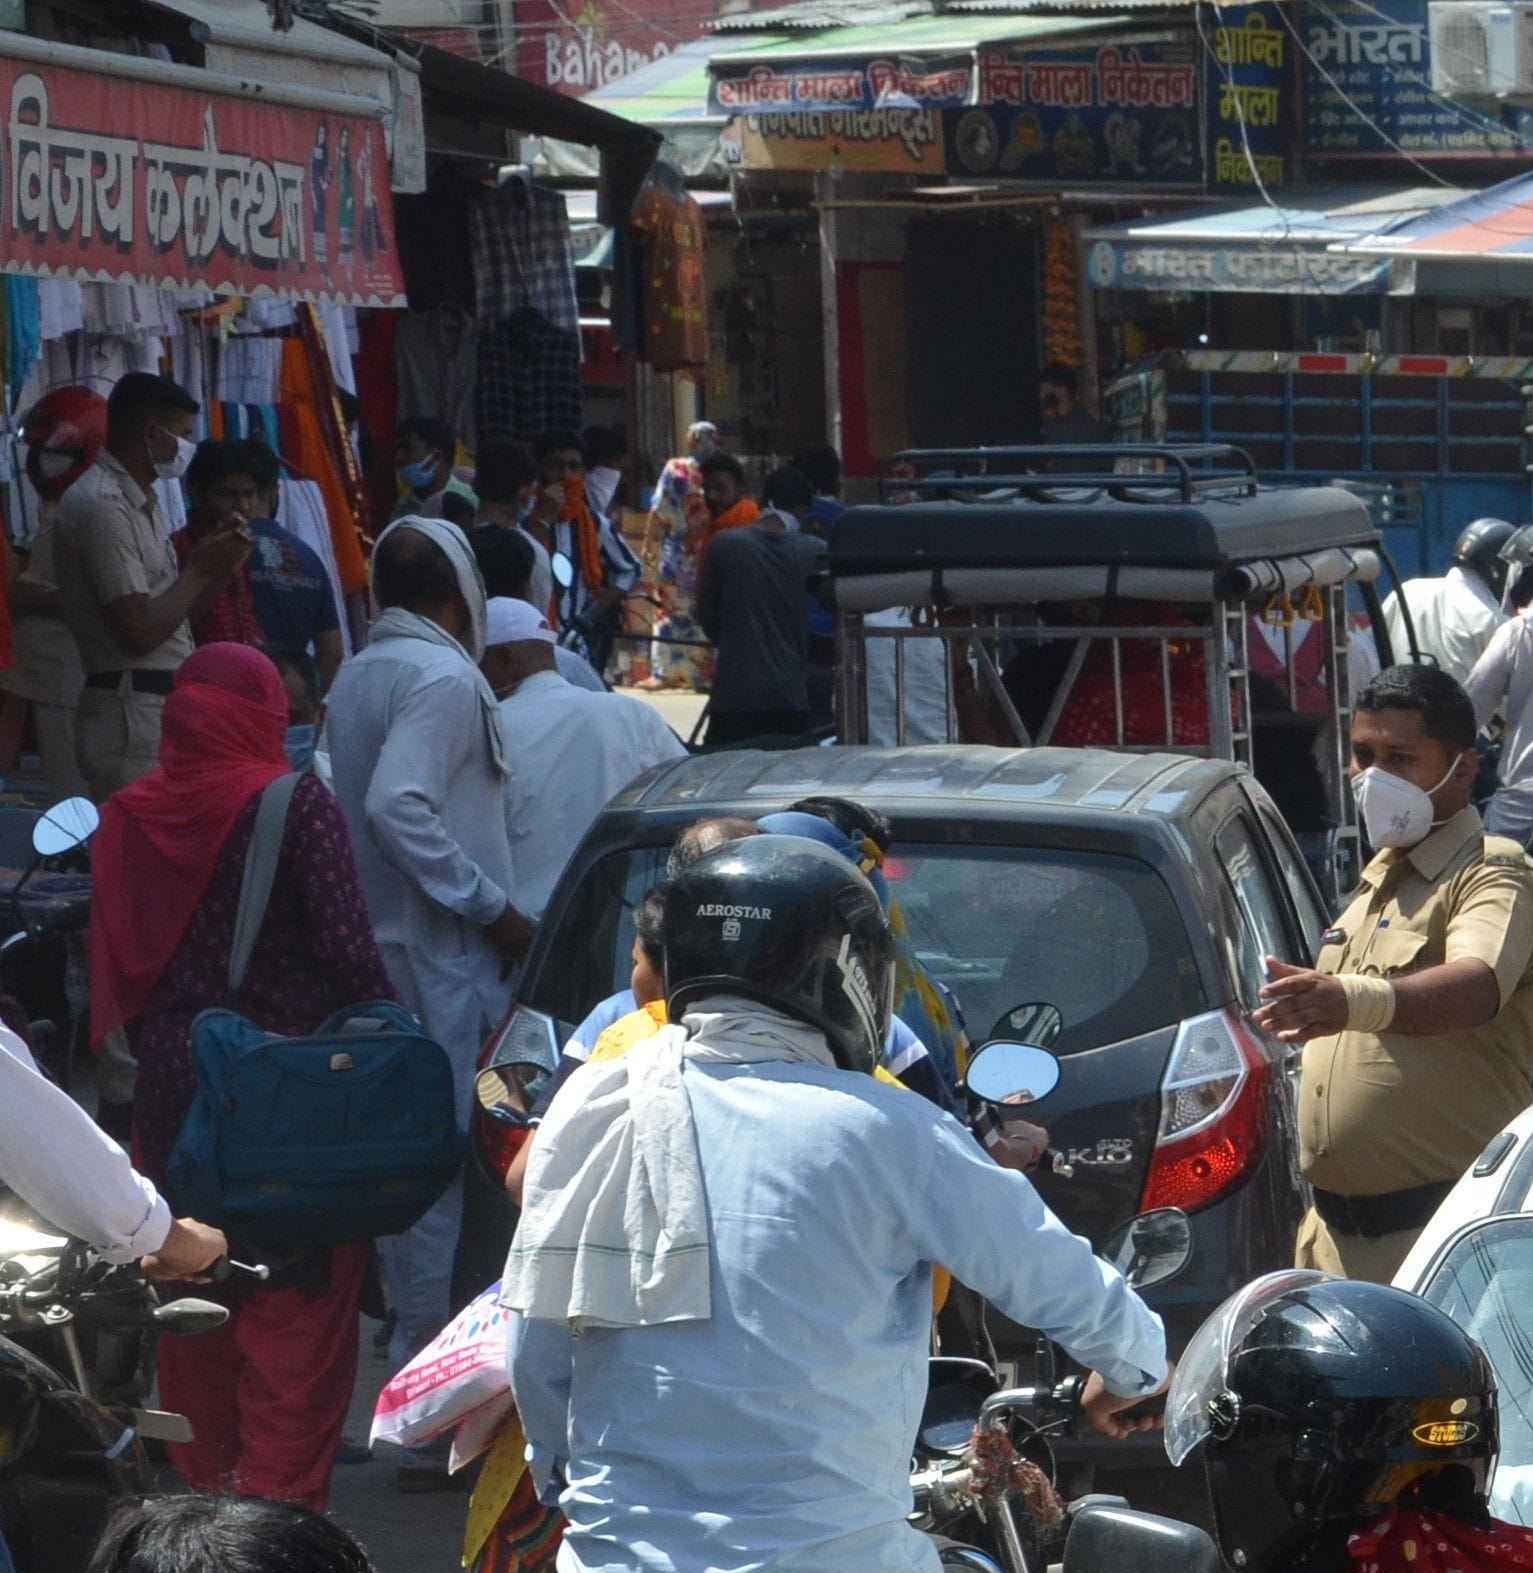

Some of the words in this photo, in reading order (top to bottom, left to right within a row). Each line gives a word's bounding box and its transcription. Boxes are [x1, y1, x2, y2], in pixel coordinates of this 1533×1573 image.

[1308, 22, 1427, 65] भारत
[796, 70, 862, 103] माला
[1028, 61, 1093, 107] माला
[1096, 45, 1196, 108] निकेतन
[8, 74, 139, 248] विजय
[143, 104, 306, 266] कलेक्शन
[696, 904, 772, 920] AEROSTAR
[1068, 1147, 1132, 1164] K10
[1097, 1138, 1133, 1151] ALTO
